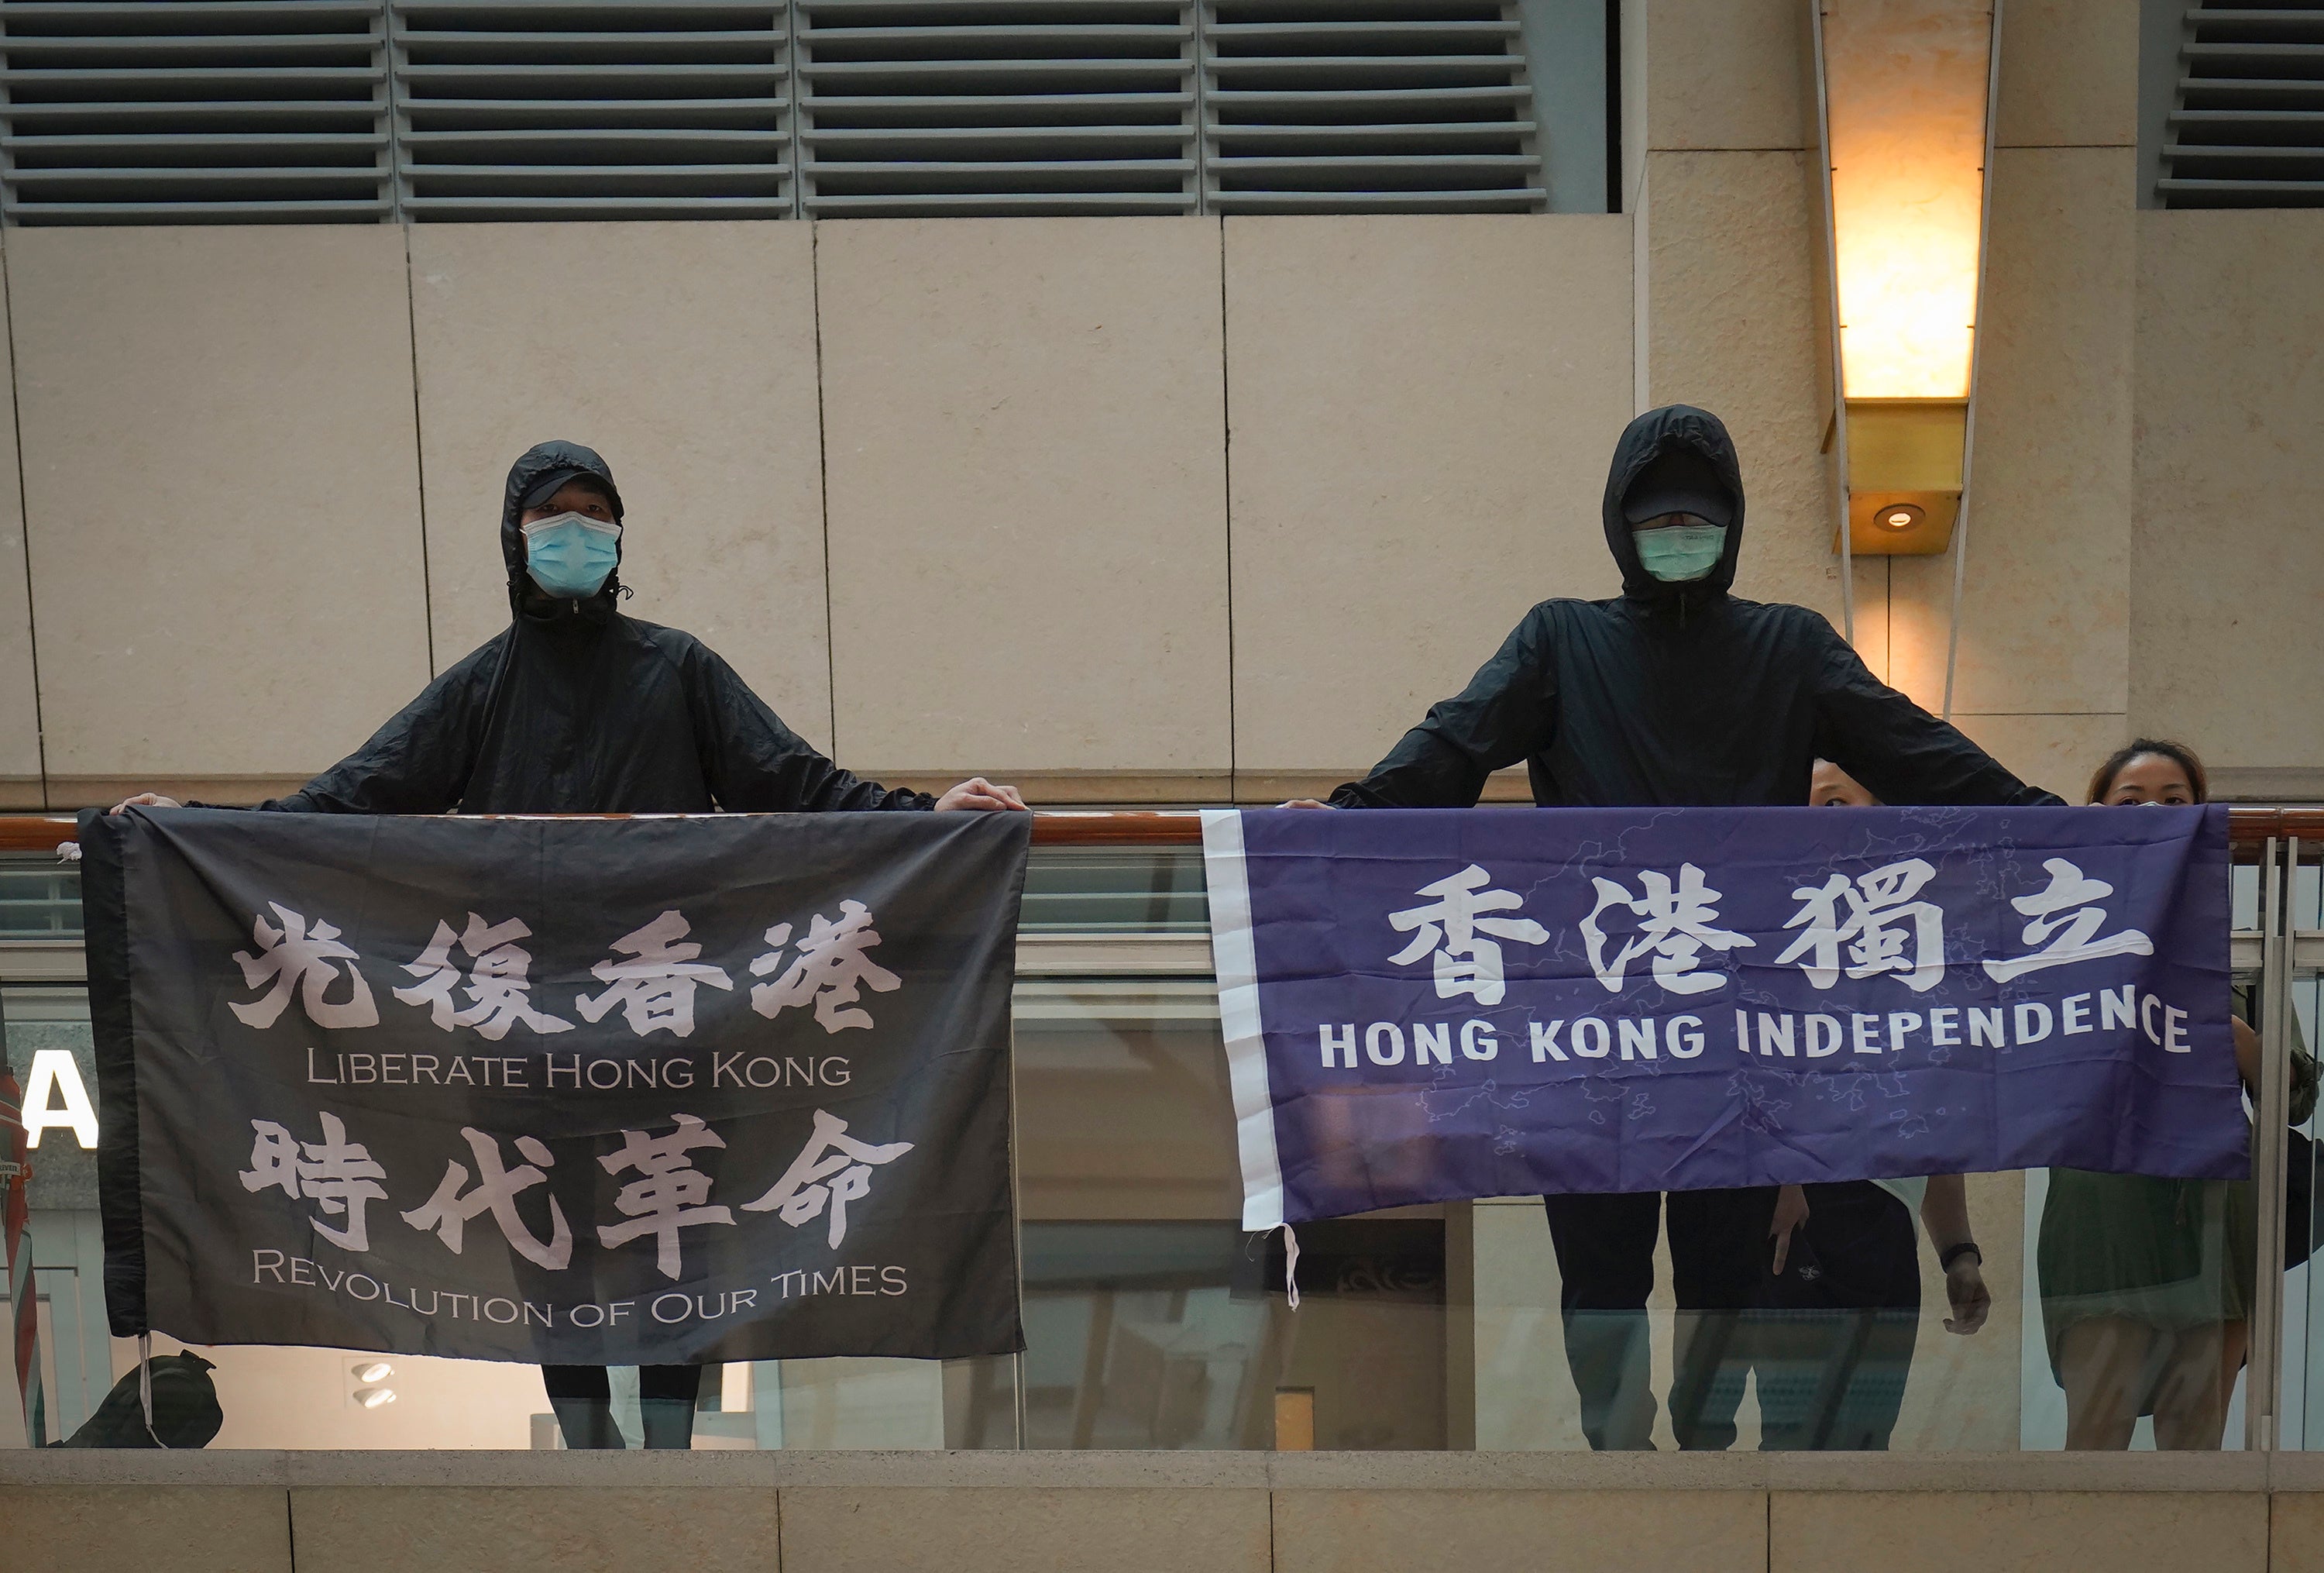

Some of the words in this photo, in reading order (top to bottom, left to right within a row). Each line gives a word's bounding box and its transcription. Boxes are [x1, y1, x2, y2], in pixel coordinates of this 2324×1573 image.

[227, 898, 902, 1041] 光復香港
[1387, 858, 2154, 1006] 香港獨立
[307, 1047, 529, 1088] LIBERATE
[545, 1052, 694, 1089] HONG
[713, 1052, 851, 1087] KONG
[1318, 1018, 1499, 1069] HONG
[1528, 1016, 1705, 1063] KONG
[1736, 984, 2192, 1058] INDEPENDENCE
[238, 1108, 916, 1281] 時代革命
[253, 1249, 553, 1328] REVOLUTION
[569, 1300, 635, 1327] OF
[651, 1289, 758, 1323] OUR
[770, 1265, 908, 1299] TIMES
